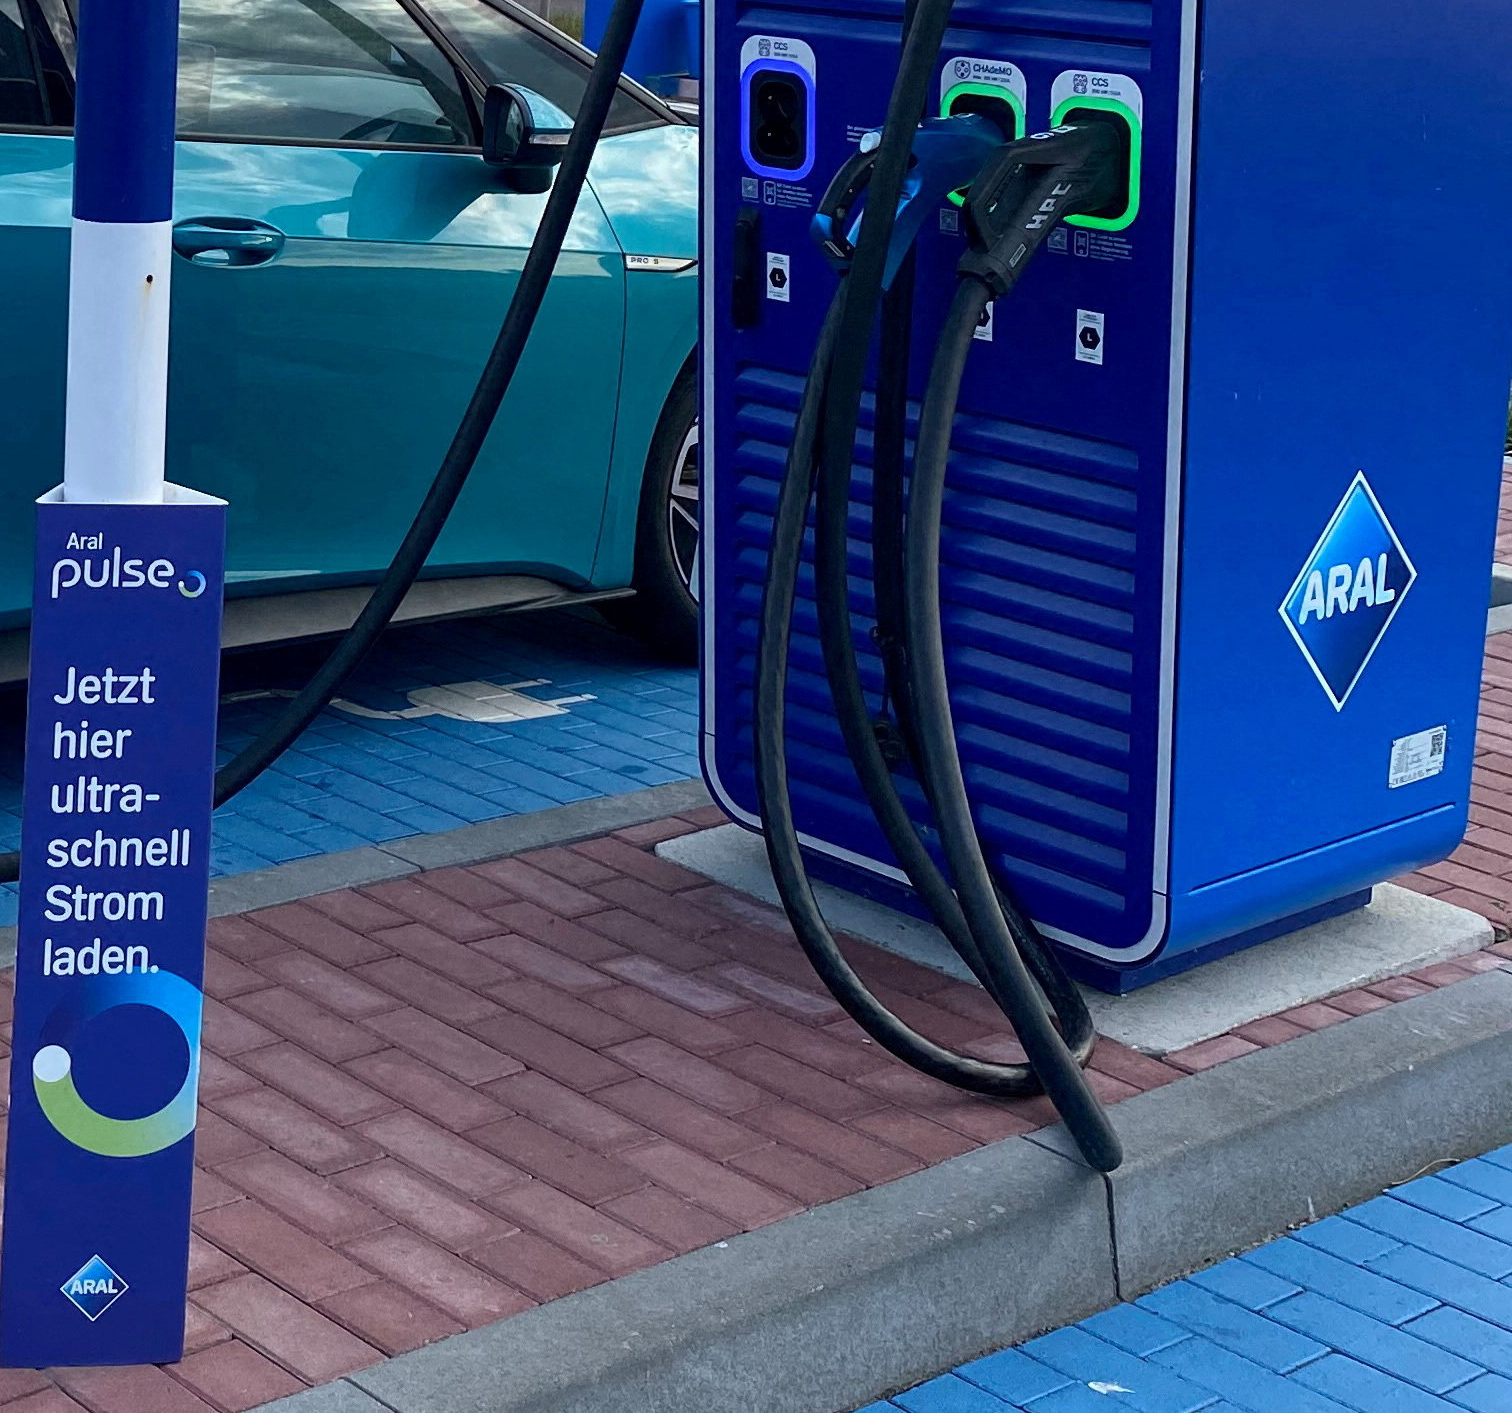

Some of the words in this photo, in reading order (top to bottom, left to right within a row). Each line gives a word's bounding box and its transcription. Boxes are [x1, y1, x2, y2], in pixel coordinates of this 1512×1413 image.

[773, 41, 788, 51] CCS
[1091, 77, 1109, 88] CCS
[1025, 183, 1072, 229] HPC
[630, 256, 649, 265] PRO
[65, 532, 103, 551] Aral
[51, 546, 176, 599] pulse
[1299, 552, 1395, 625] ARAL
[53, 666, 156, 705] Jetzt
[53, 720, 133, 759] hier
[50, 776, 161, 814] ultra-
[46, 828, 191, 868] schnell
[43, 884, 164, 922] Strom
[43, 938, 159, 977] laden.
[70, 1278, 119, 1295] ARAL
